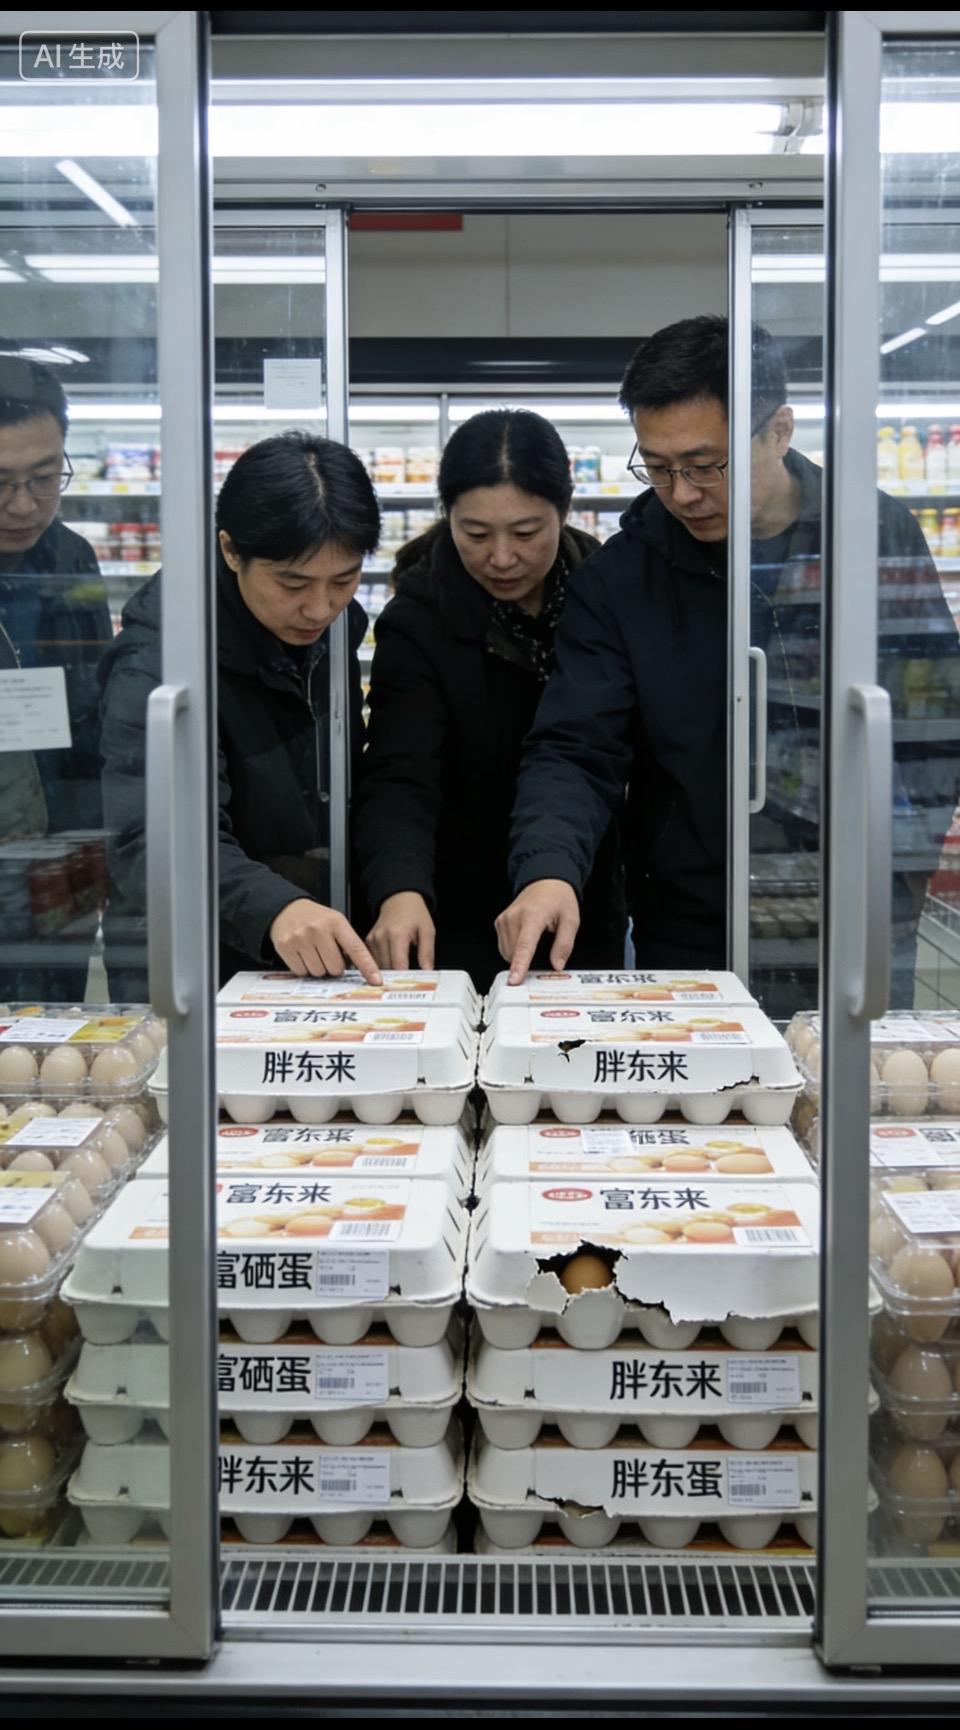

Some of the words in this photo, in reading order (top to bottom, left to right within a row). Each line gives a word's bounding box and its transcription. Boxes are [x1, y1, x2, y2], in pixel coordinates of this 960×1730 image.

[262, 1051, 356, 1083] 胖东来
[594, 1050, 689, 1083] 胖东来
[227, 1183, 332, 1203] 富东来
[599, 1187, 710, 1210] 富东来
[610, 1360, 722, 1399] 胖东来
[611, 1458, 723, 1498] 胖东蛋
